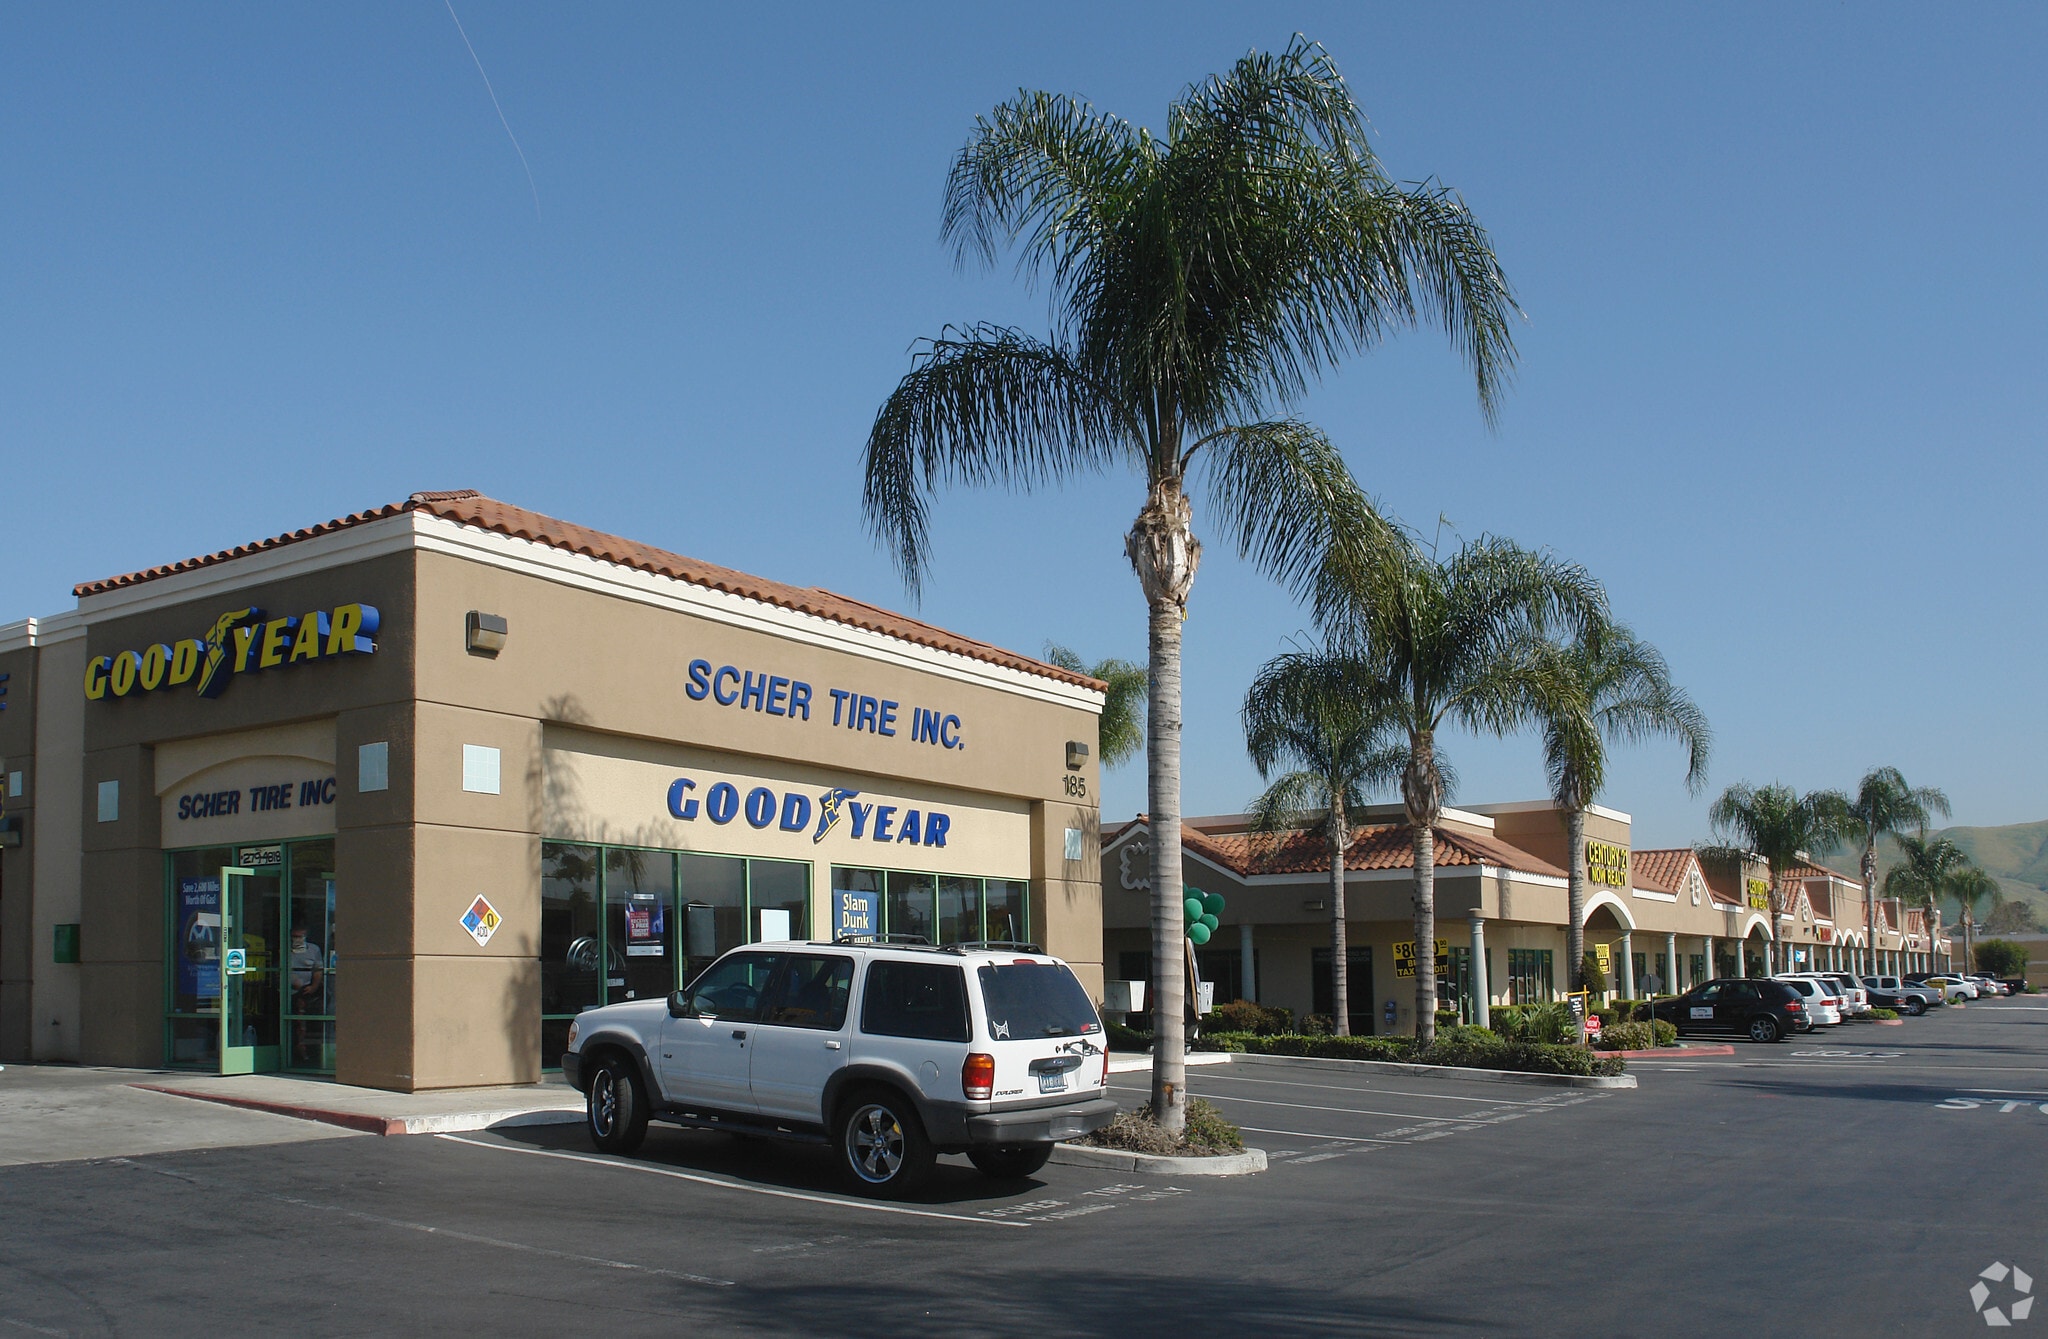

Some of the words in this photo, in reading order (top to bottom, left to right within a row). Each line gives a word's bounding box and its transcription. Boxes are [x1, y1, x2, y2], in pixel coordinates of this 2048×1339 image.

[84, 603, 379, 700] GOODYEAR
[685, 658, 812, 721] SCHER
[829, 688, 899, 737] TIRE
[911, 706, 965, 751] INC.
[1062, 774, 1086, 798] 185
[177, 790, 241, 820] SCHER
[249, 783, 293, 812] TIRE
[299, 777, 336, 807] INC
[667, 777, 950, 848] GOODYEAR
[1587, 841, 1619, 867] CENTURY
[1590, 866, 1606, 884] NOW
[1607, 869, 1626, 887] REALTY
[842, 893, 868, 912] Slam
[487, 913, 494, 928] 0
[842, 912, 869, 929] Dunk
[1398, 968, 1415, 976] TAX
[1934, 1097, 2048, 1115] ST
[977, 1199, 1070, 1218] SCHER
[1082, 1183, 1145, 1197] TIRE
